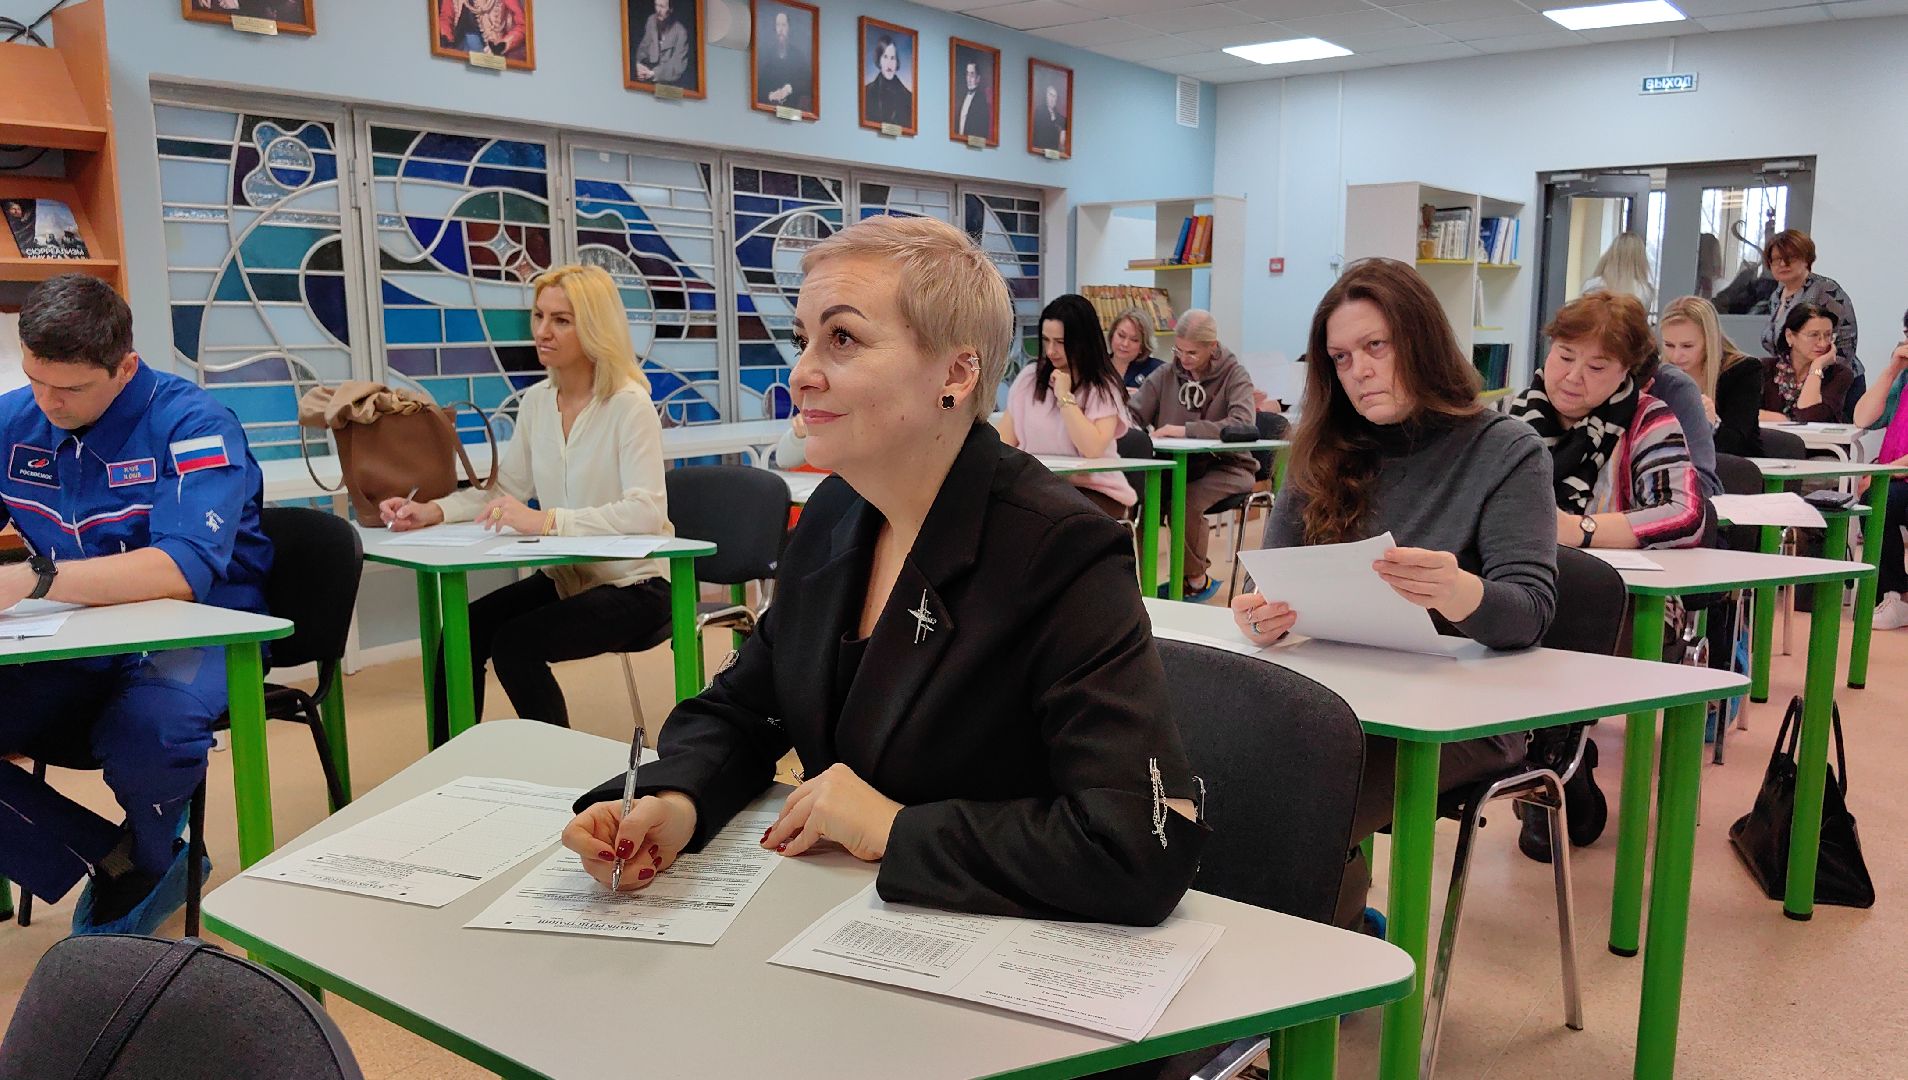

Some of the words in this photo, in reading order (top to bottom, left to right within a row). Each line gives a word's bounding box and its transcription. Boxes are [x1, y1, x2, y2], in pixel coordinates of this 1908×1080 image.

[1645, 76, 1692, 89] ВЫХОД
[25, 247, 85, 256] СЮРРЕАЛИЗМ
[19, 469, 53, 480] РОСКОСМОС
[537, 919, 605, 929] РЕГИСТРАЦИИ
[607, 922, 639, 931] БЛАНК
